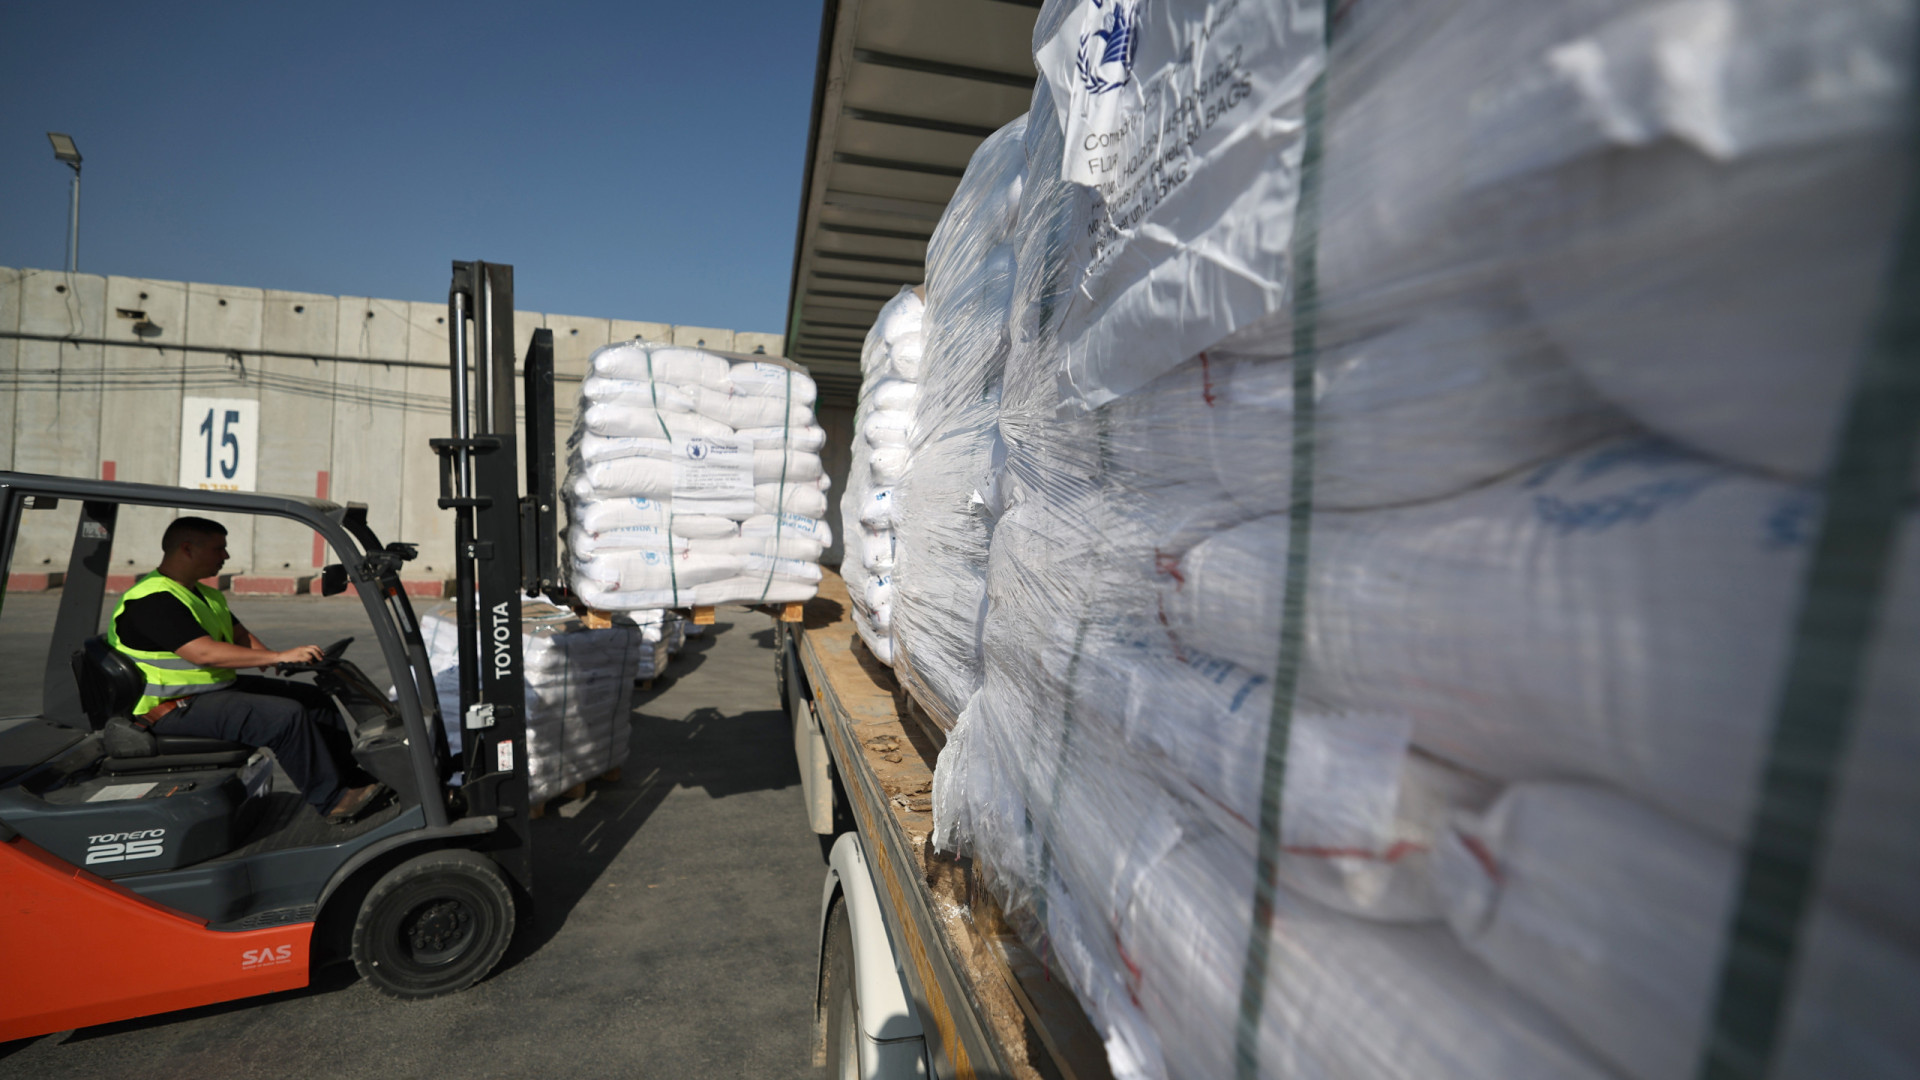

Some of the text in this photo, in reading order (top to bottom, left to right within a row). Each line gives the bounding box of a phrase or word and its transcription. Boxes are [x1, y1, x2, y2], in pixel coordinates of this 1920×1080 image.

[200, 408, 240, 479] 15
[492, 601, 512, 680] TOYOTA
[86, 838, 164, 865] 25
[242, 944, 292, 966] SAS
